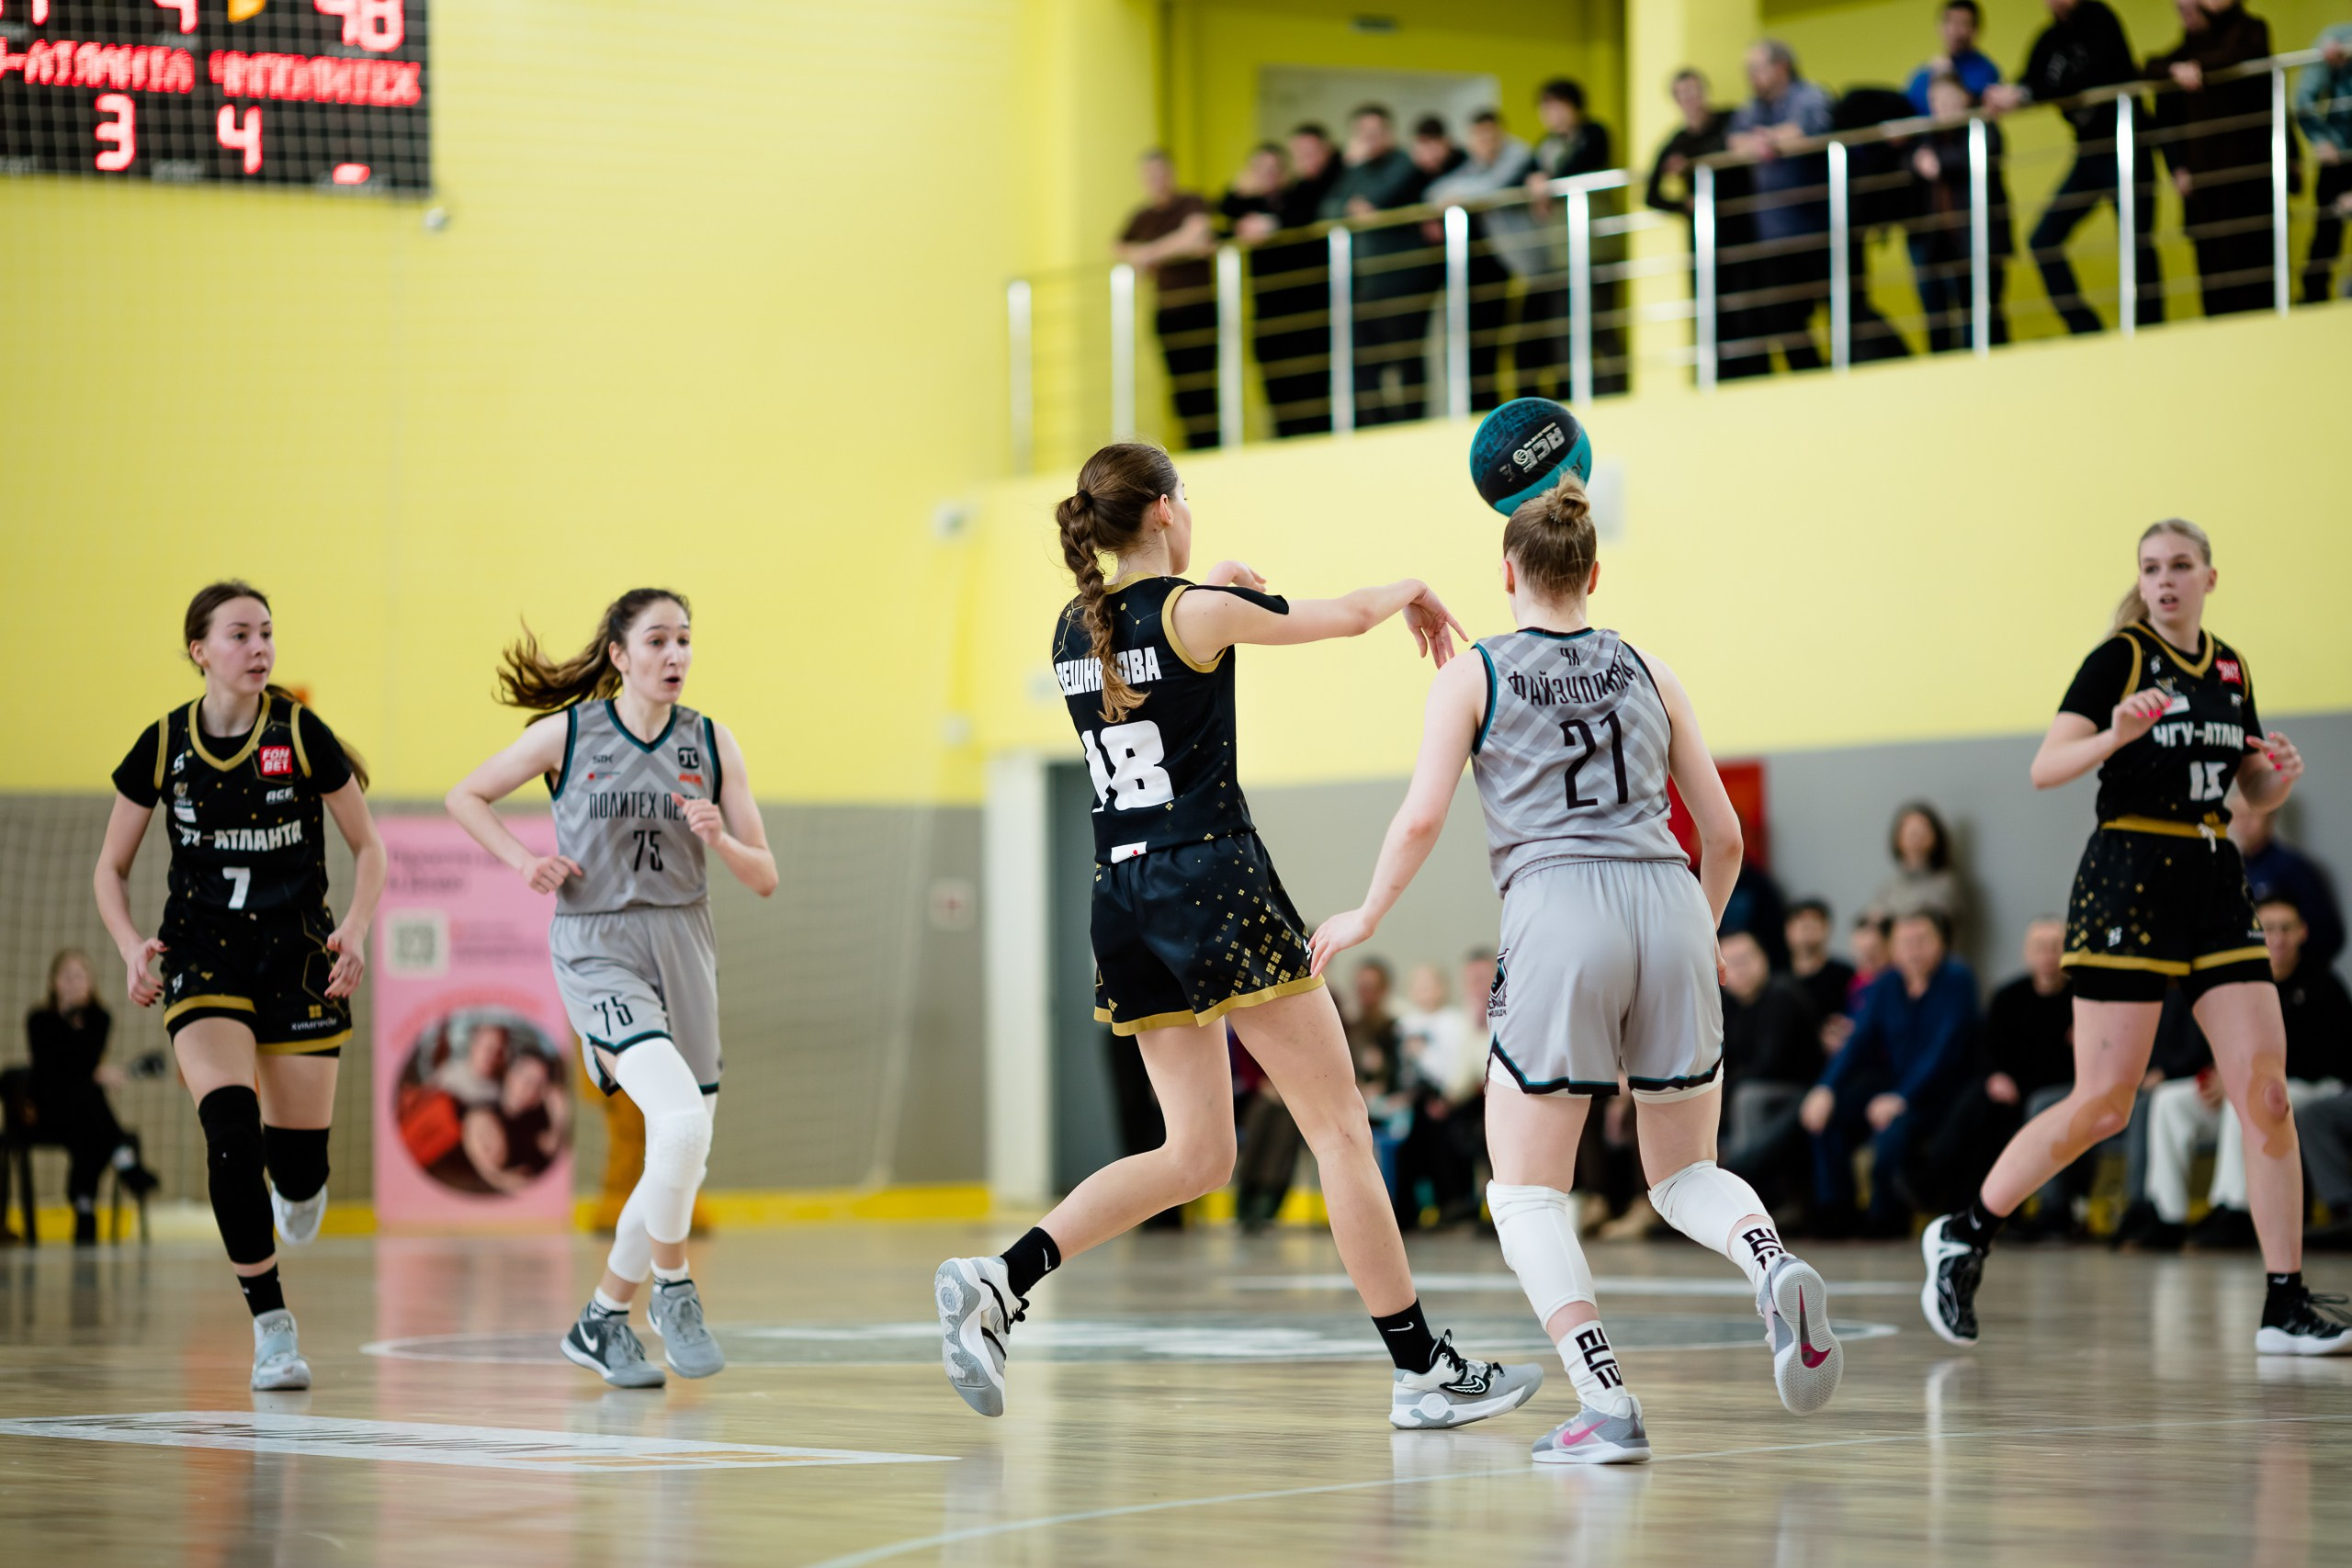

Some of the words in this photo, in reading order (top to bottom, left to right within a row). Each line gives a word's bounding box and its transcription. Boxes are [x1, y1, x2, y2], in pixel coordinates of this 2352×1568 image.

[95, 94, 135, 172] 3
[217, 104, 263, 175] 4
[1081, 719, 1175, 814] 18
[1559, 710, 1628, 809] 21
[589, 792, 657, 819] ПОЛИТЕХ
[633, 829, 663, 872] 75
[222, 867, 251, 909] 7
[593, 996, 634, 1036] 75
